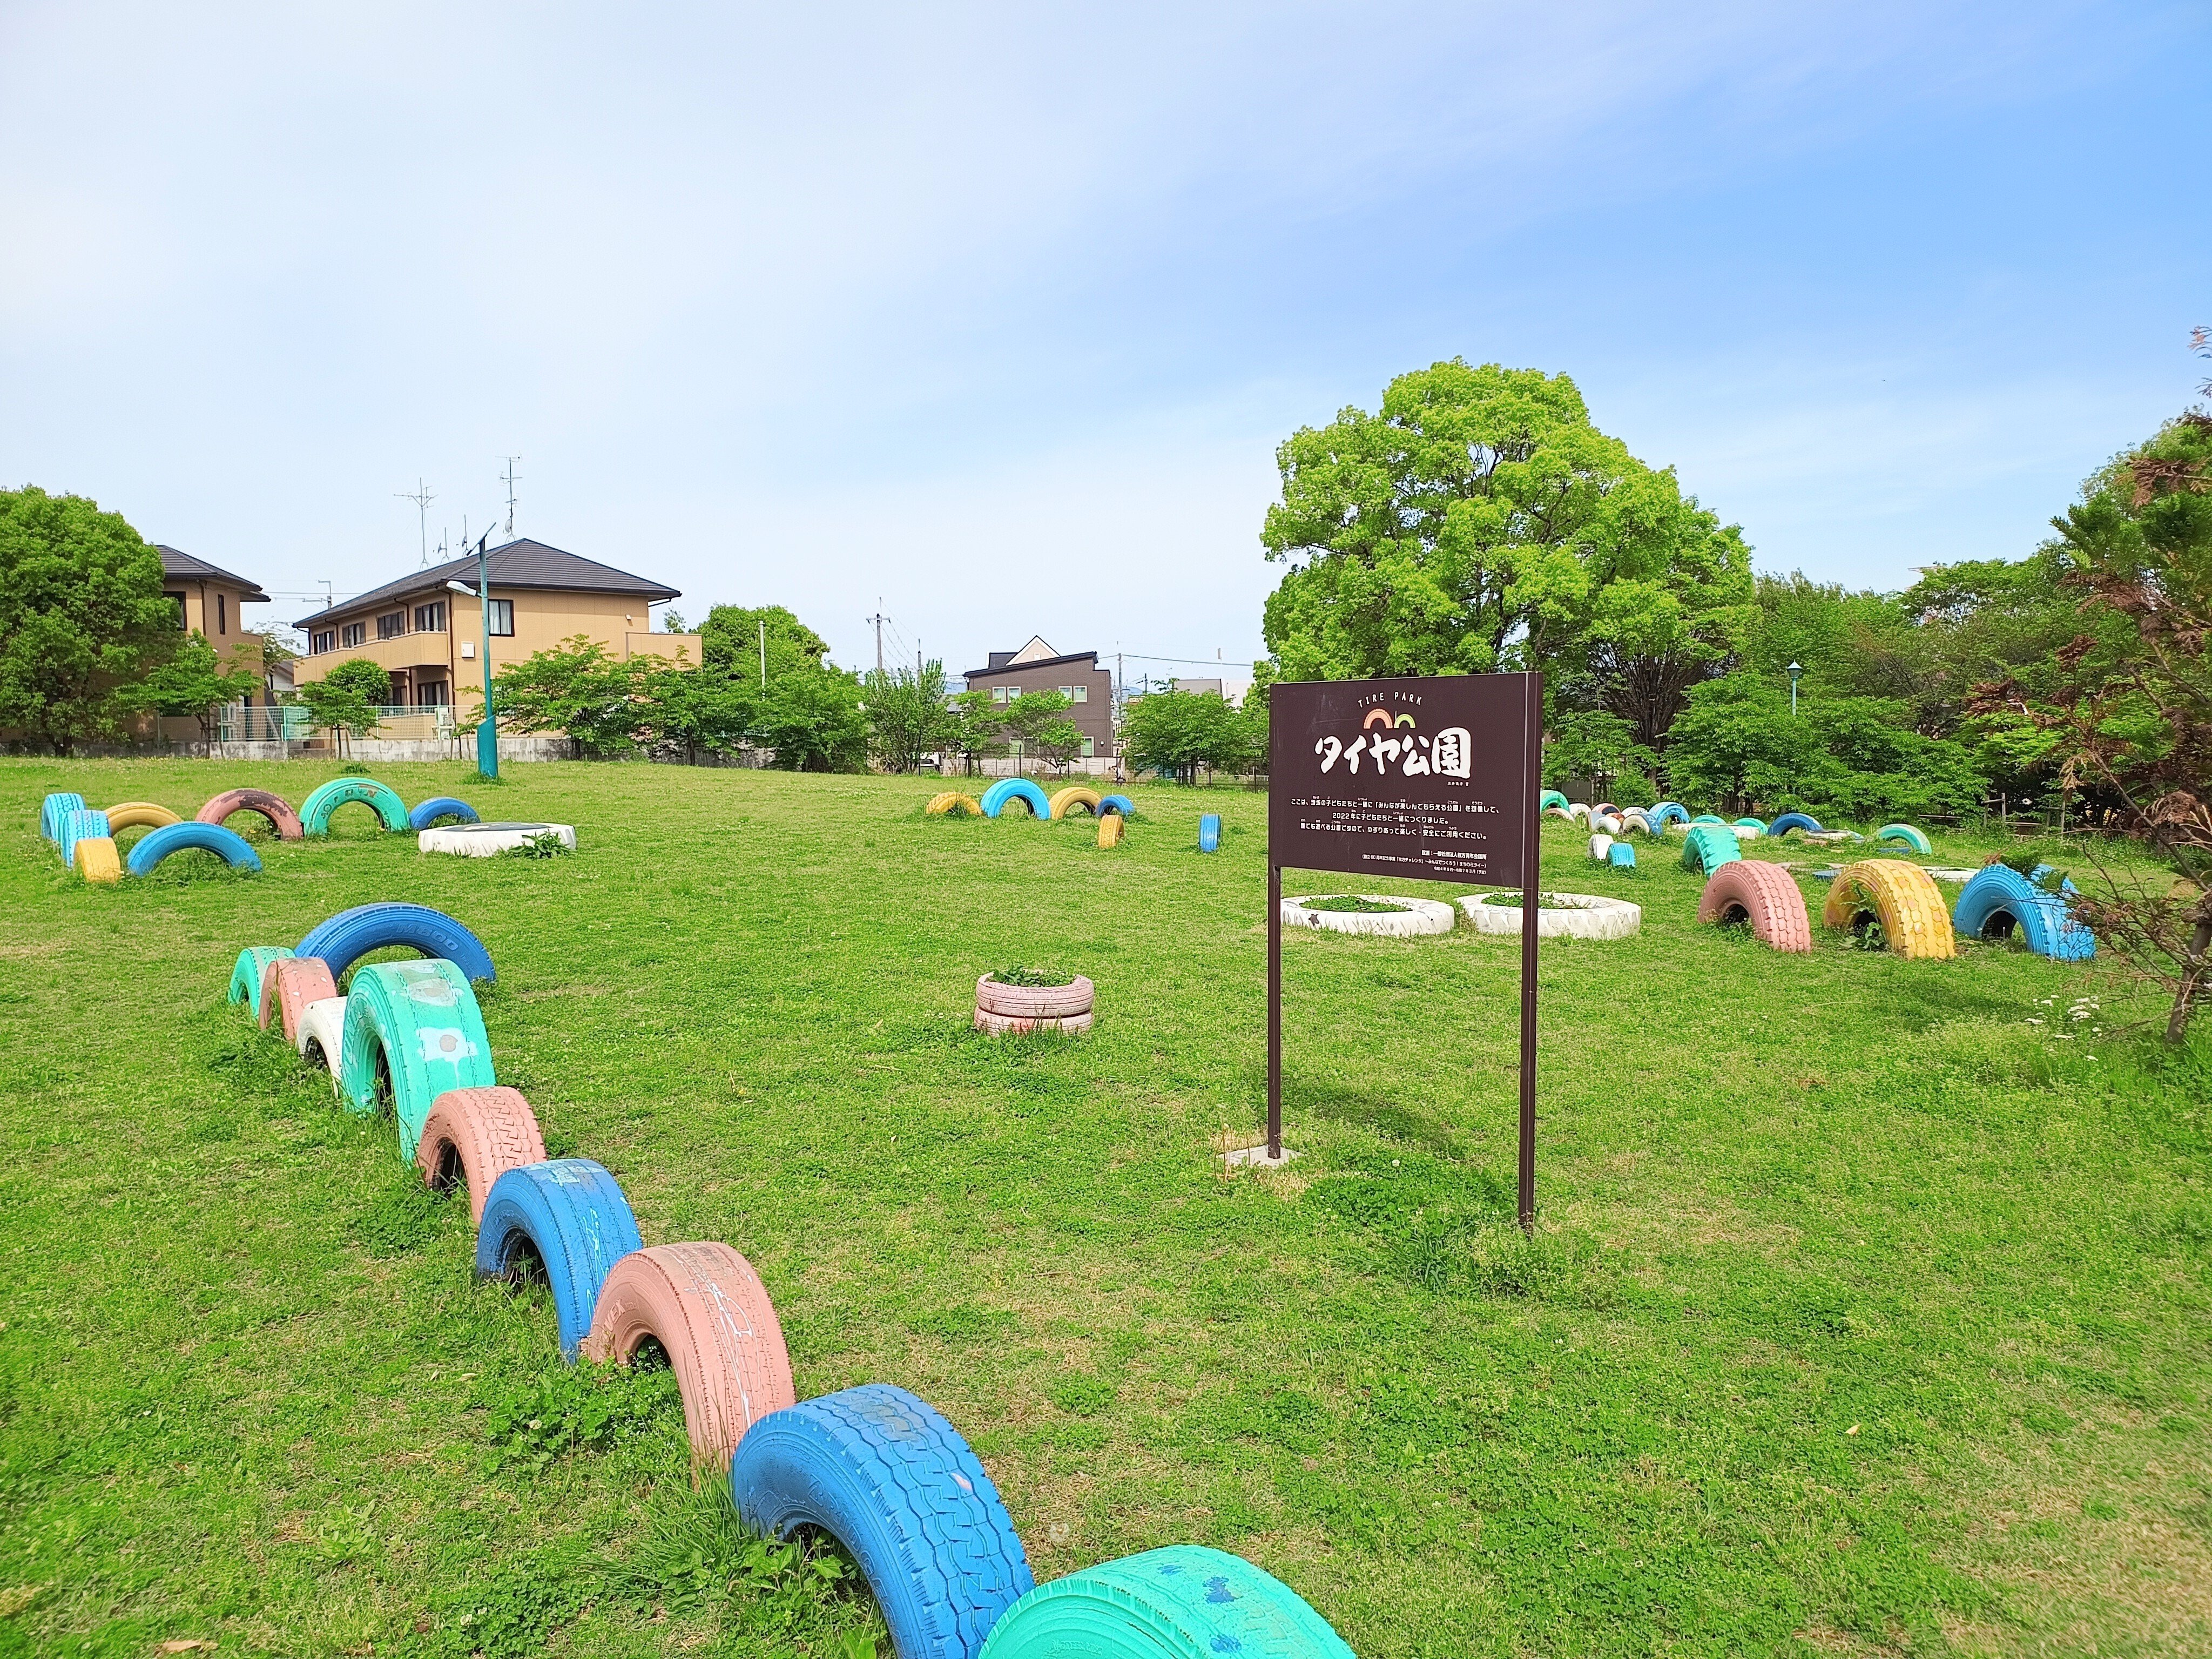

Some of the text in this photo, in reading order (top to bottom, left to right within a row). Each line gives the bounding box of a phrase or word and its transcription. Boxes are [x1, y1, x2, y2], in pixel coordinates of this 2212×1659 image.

[1358, 692, 1421, 707] TIRE PARK
[1315, 727, 1471, 779] タイヤ公園
